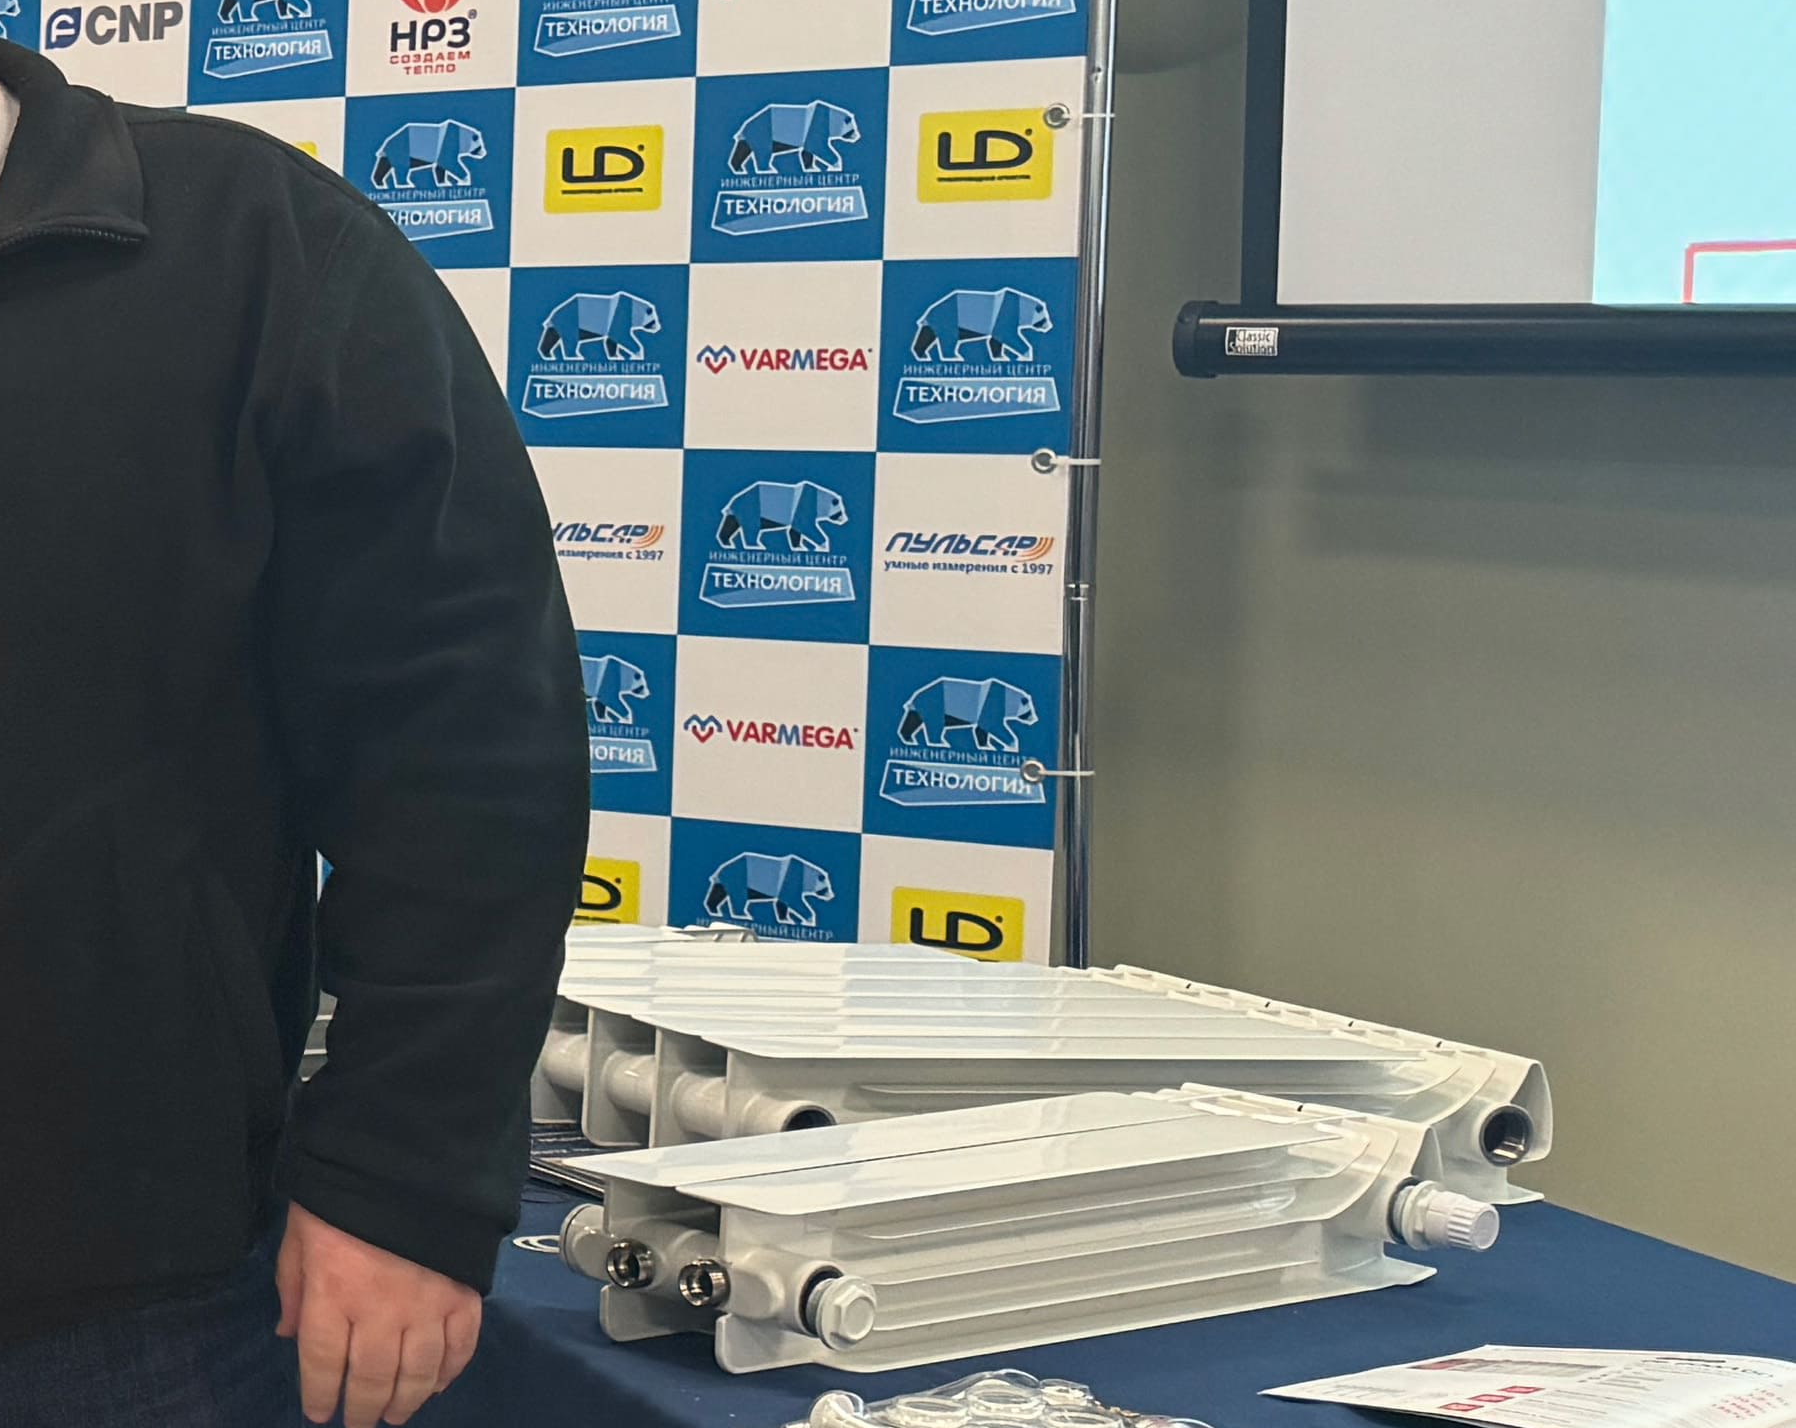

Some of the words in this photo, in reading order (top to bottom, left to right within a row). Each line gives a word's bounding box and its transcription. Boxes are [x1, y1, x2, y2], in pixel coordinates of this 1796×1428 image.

[86, 1, 183, 45] CNP
[544, 14, 669, 37] ТЕХНОЛОГИЯ
[214, 39, 321, 61] ТЕХНОЛОГИЯ
[390, 51, 470, 65] СОЗДАЕМ
[403, 64, 456, 75] ТЕПЛО
[938, 130, 1033, 170] LD
[562, 146, 644, 183] LD
[723, 195, 855, 215] ТЕХНОЛОГИЯ
[388, 208, 481, 226] ХНОЛОГИЯ
[740, 348, 868, 371] VARMEGA
[1007, 364, 1052, 376] ЦЕНТР
[533, 383, 655, 400] ТЕХНОЛОГИЯ
[906, 386, 1046, 403] ТЕХНОЛОГИЯ
[553, 522, 649, 544] ЛЬСАР
[885, 532, 1038, 556] ПУЛЬСАР
[635, 549, 664, 561] 1997
[884, 560, 930, 572] умные
[1011, 564, 1018, 574] с
[1018, 562, 1054, 575] 1997
[711, 572, 842, 592] ТЕХНОЛОГИЯ
[726, 719, 854, 750] VARMEGA
[891, 768, 1032, 795] ТЕХНОЛОГИЯ
[910, 907, 1003, 952] LD
